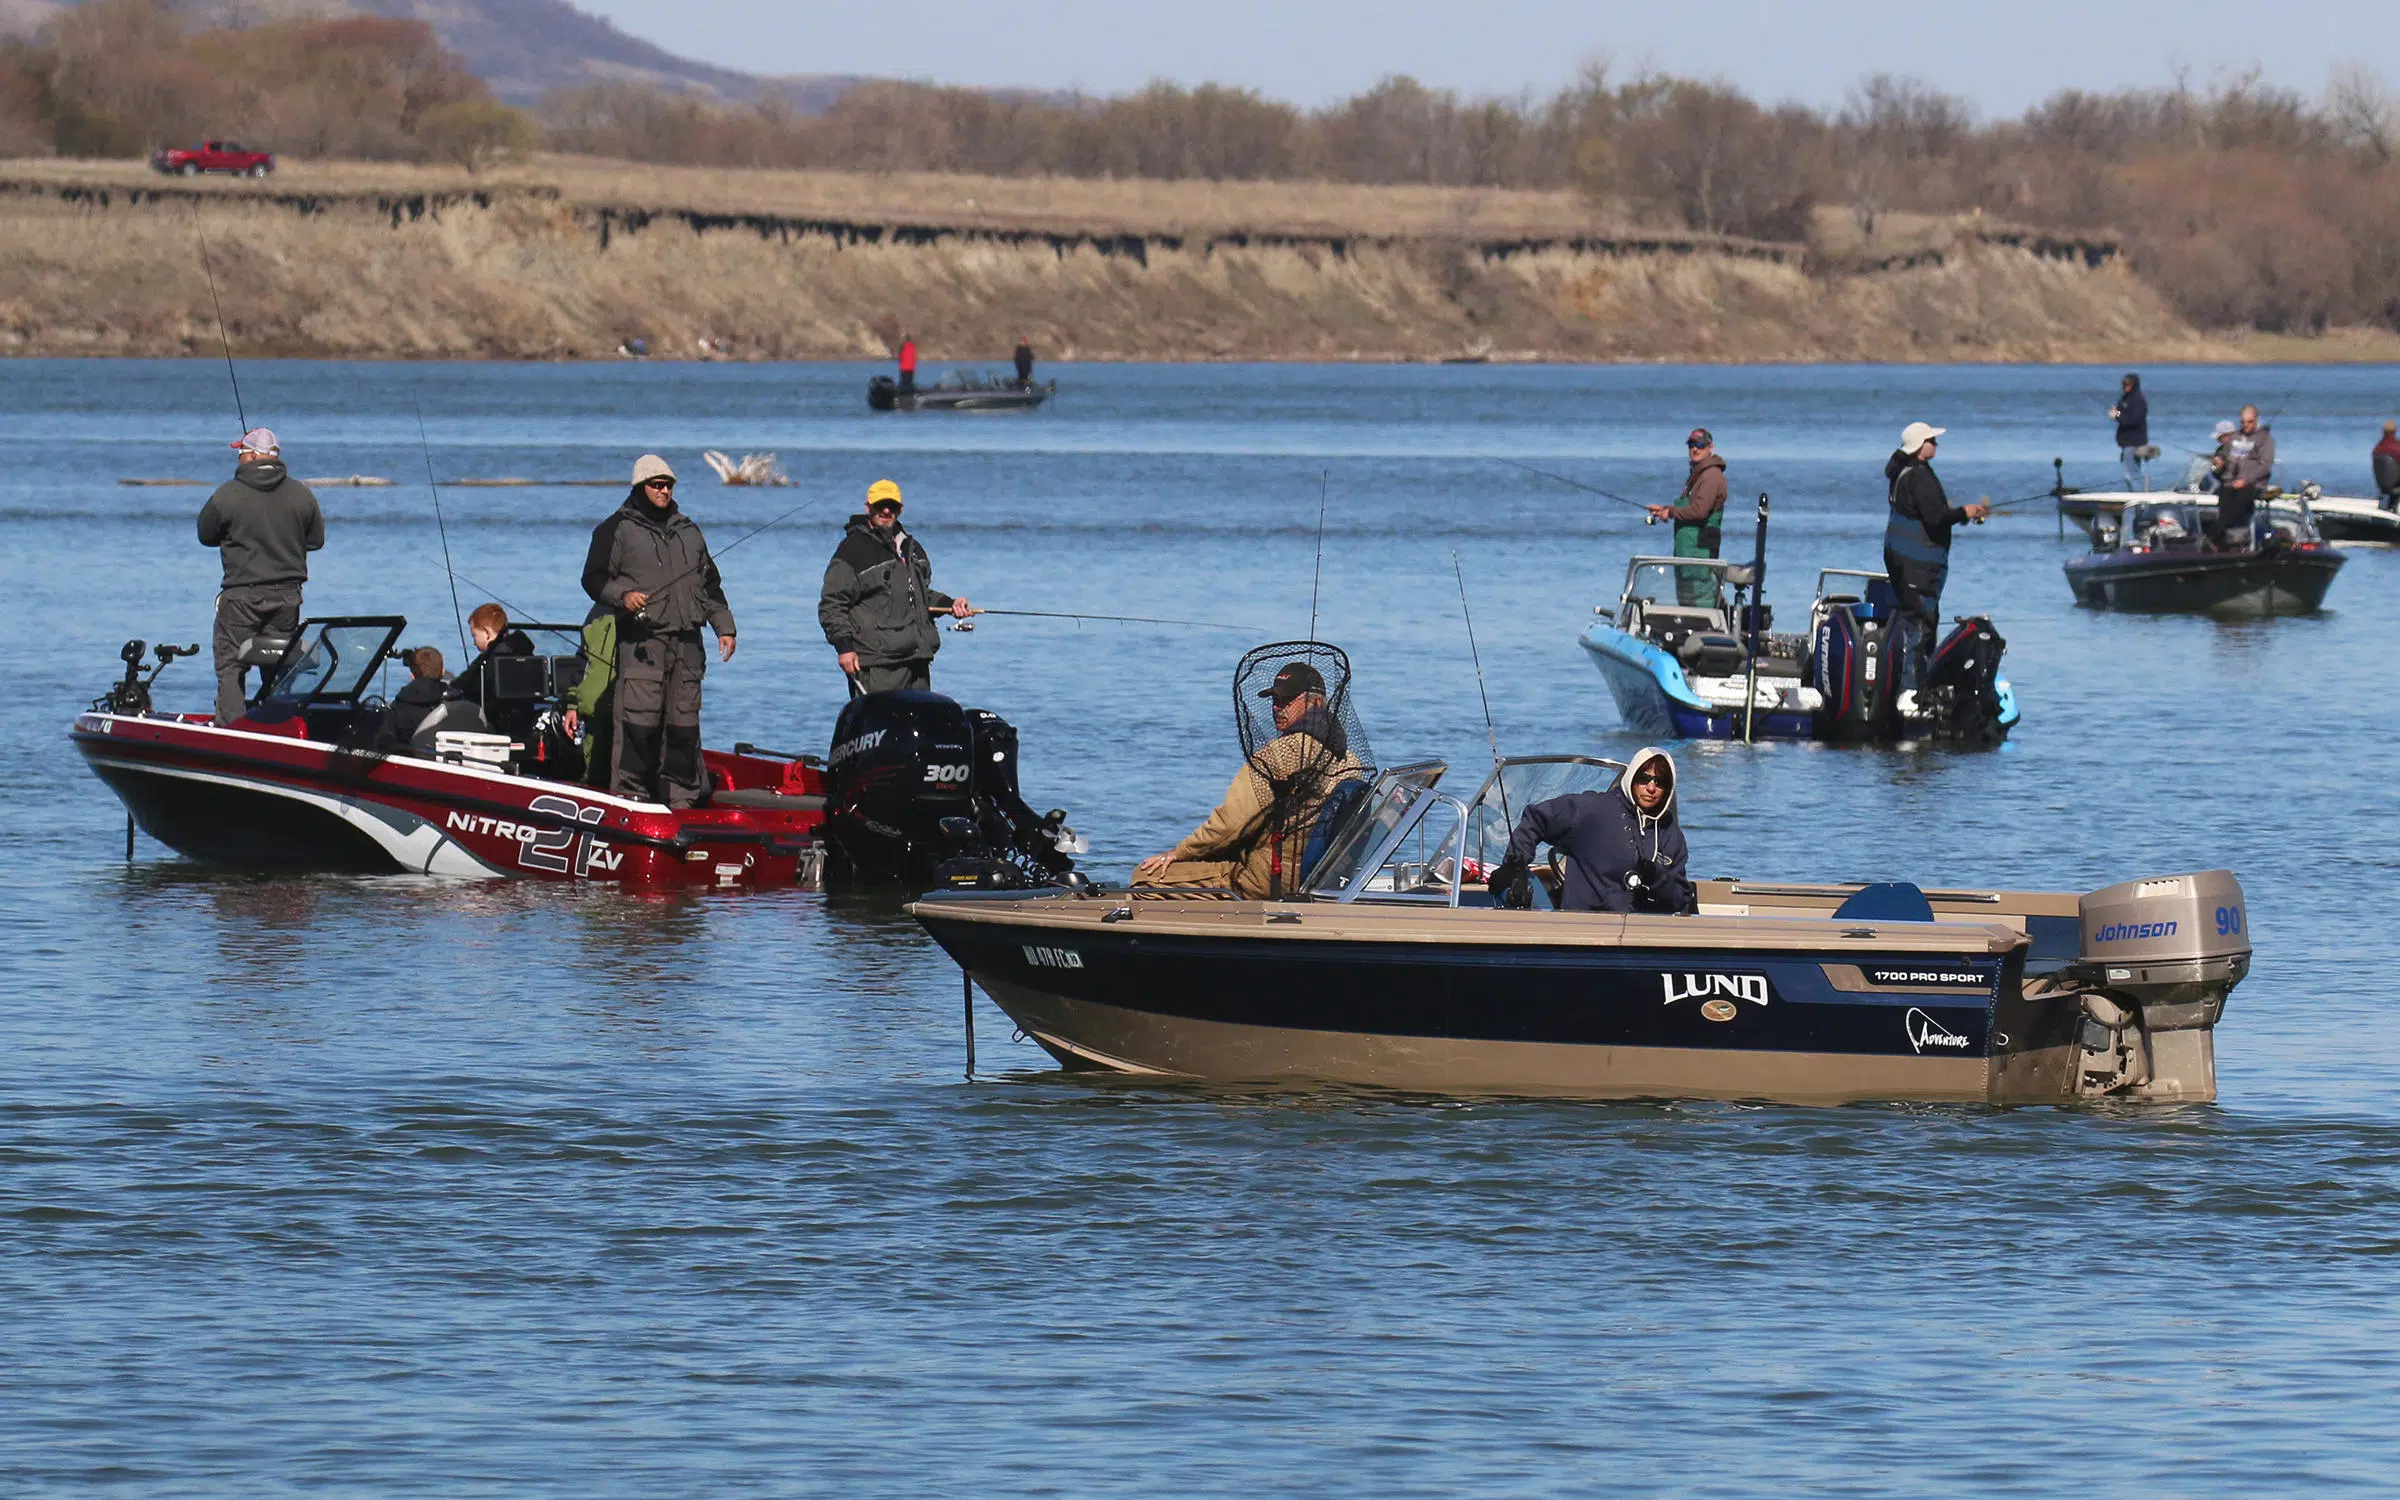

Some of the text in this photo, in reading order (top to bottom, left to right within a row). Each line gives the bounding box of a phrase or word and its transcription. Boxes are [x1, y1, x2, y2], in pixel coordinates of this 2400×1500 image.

[1821, 626, 1832, 697] EVINRUDE
[923, 764, 969, 782] 300
[2095, 921, 2178, 942] Johnson
[2215, 906, 2241, 936] 90
[1661, 973, 1769, 1006] LUND
[1874, 971, 1984, 983] 1700 PRO SPORT
